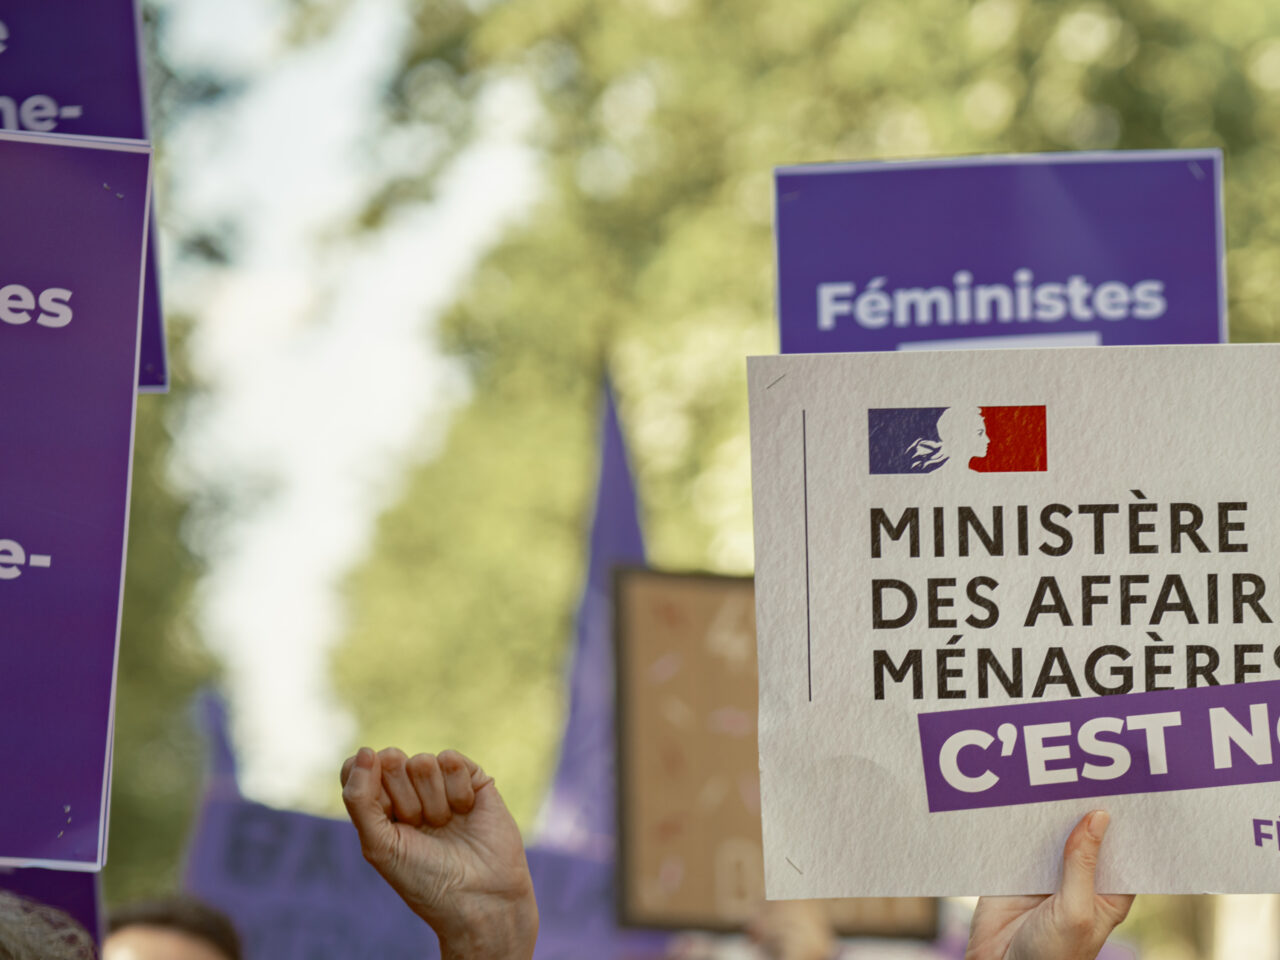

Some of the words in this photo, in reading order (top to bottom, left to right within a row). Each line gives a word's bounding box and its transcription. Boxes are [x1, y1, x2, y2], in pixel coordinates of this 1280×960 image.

[816, 268, 1166, 331] Féministes
[869, 489, 1249, 559] MINISTÈRE
[871, 575, 1000, 630] DES
